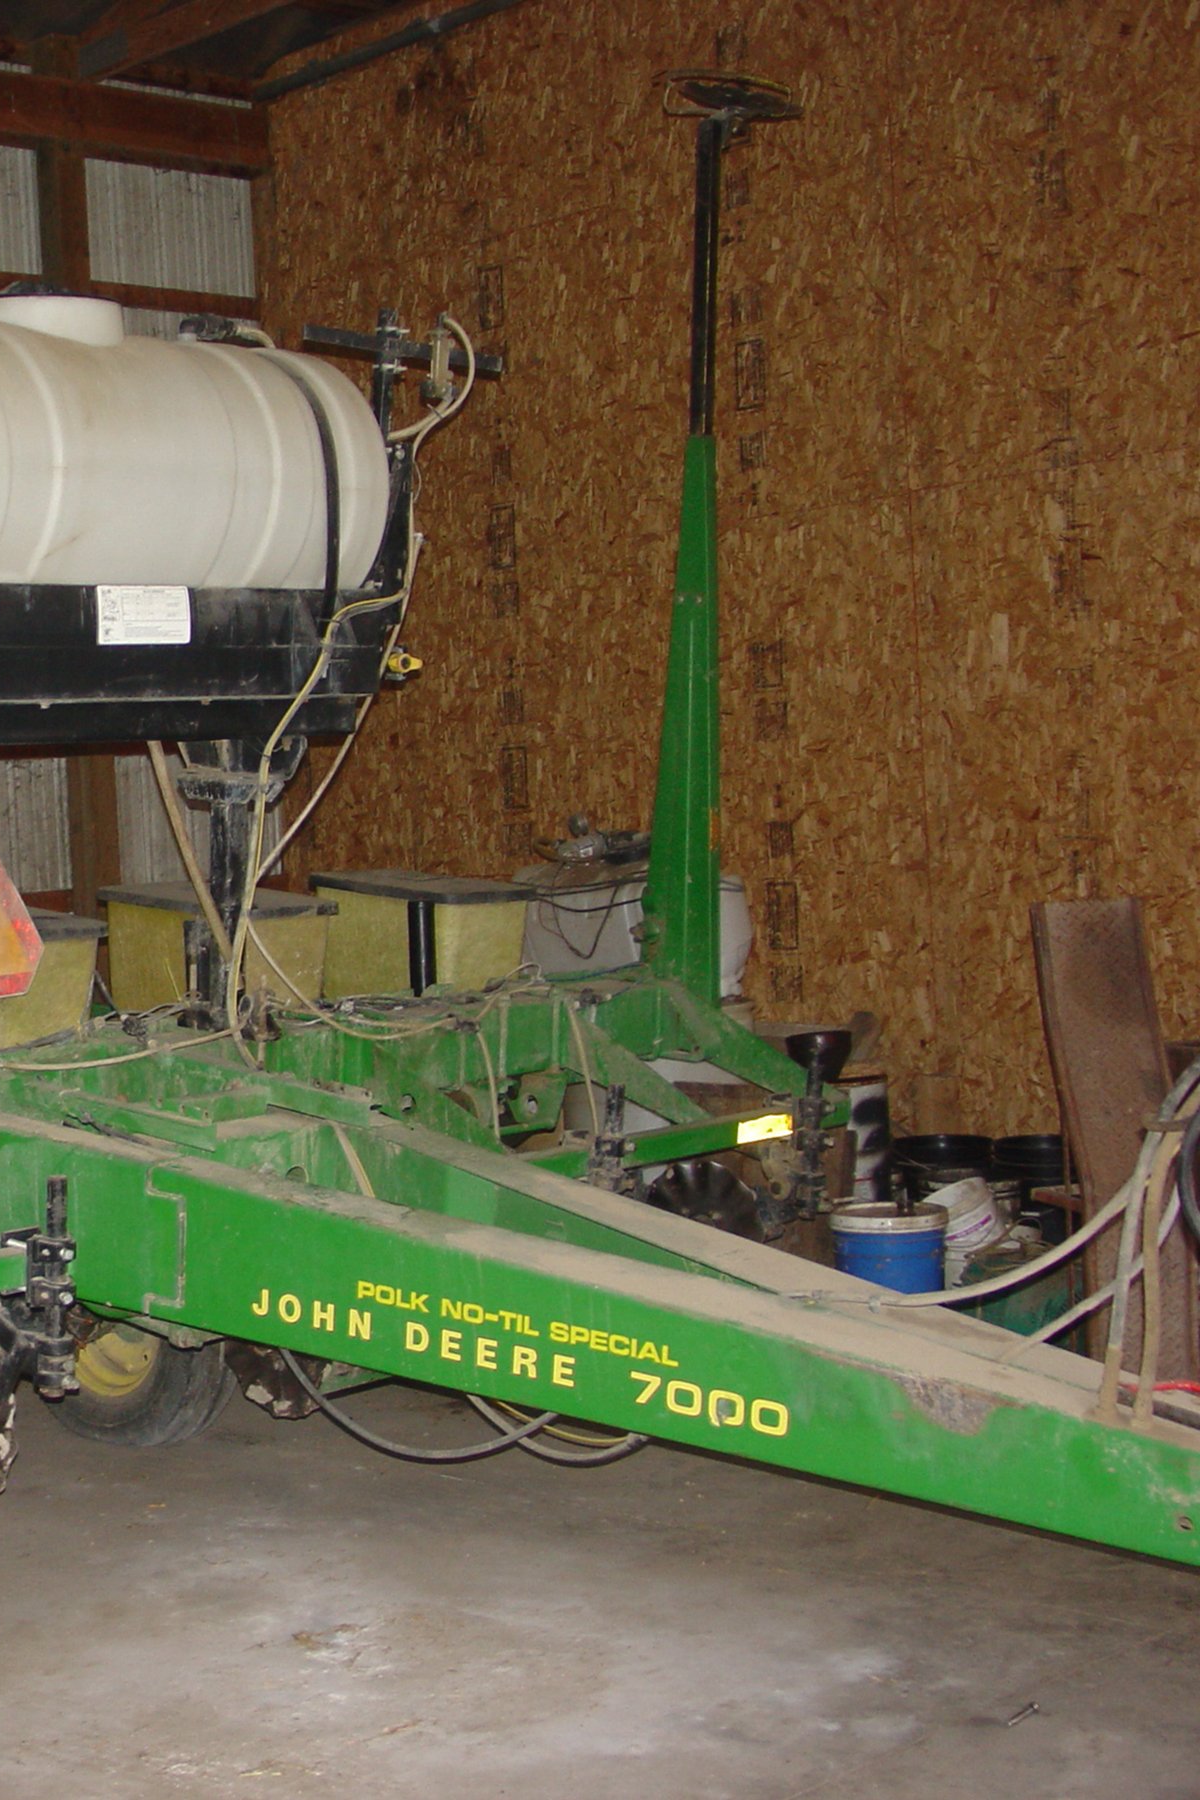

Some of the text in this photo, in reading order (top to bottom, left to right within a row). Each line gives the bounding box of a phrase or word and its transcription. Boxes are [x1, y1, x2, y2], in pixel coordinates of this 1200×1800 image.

[252, 1288, 789, 1437] JOHN DEERE 7000
[357, 1280, 679, 1367] POLK NO-TIL SPECIAL
